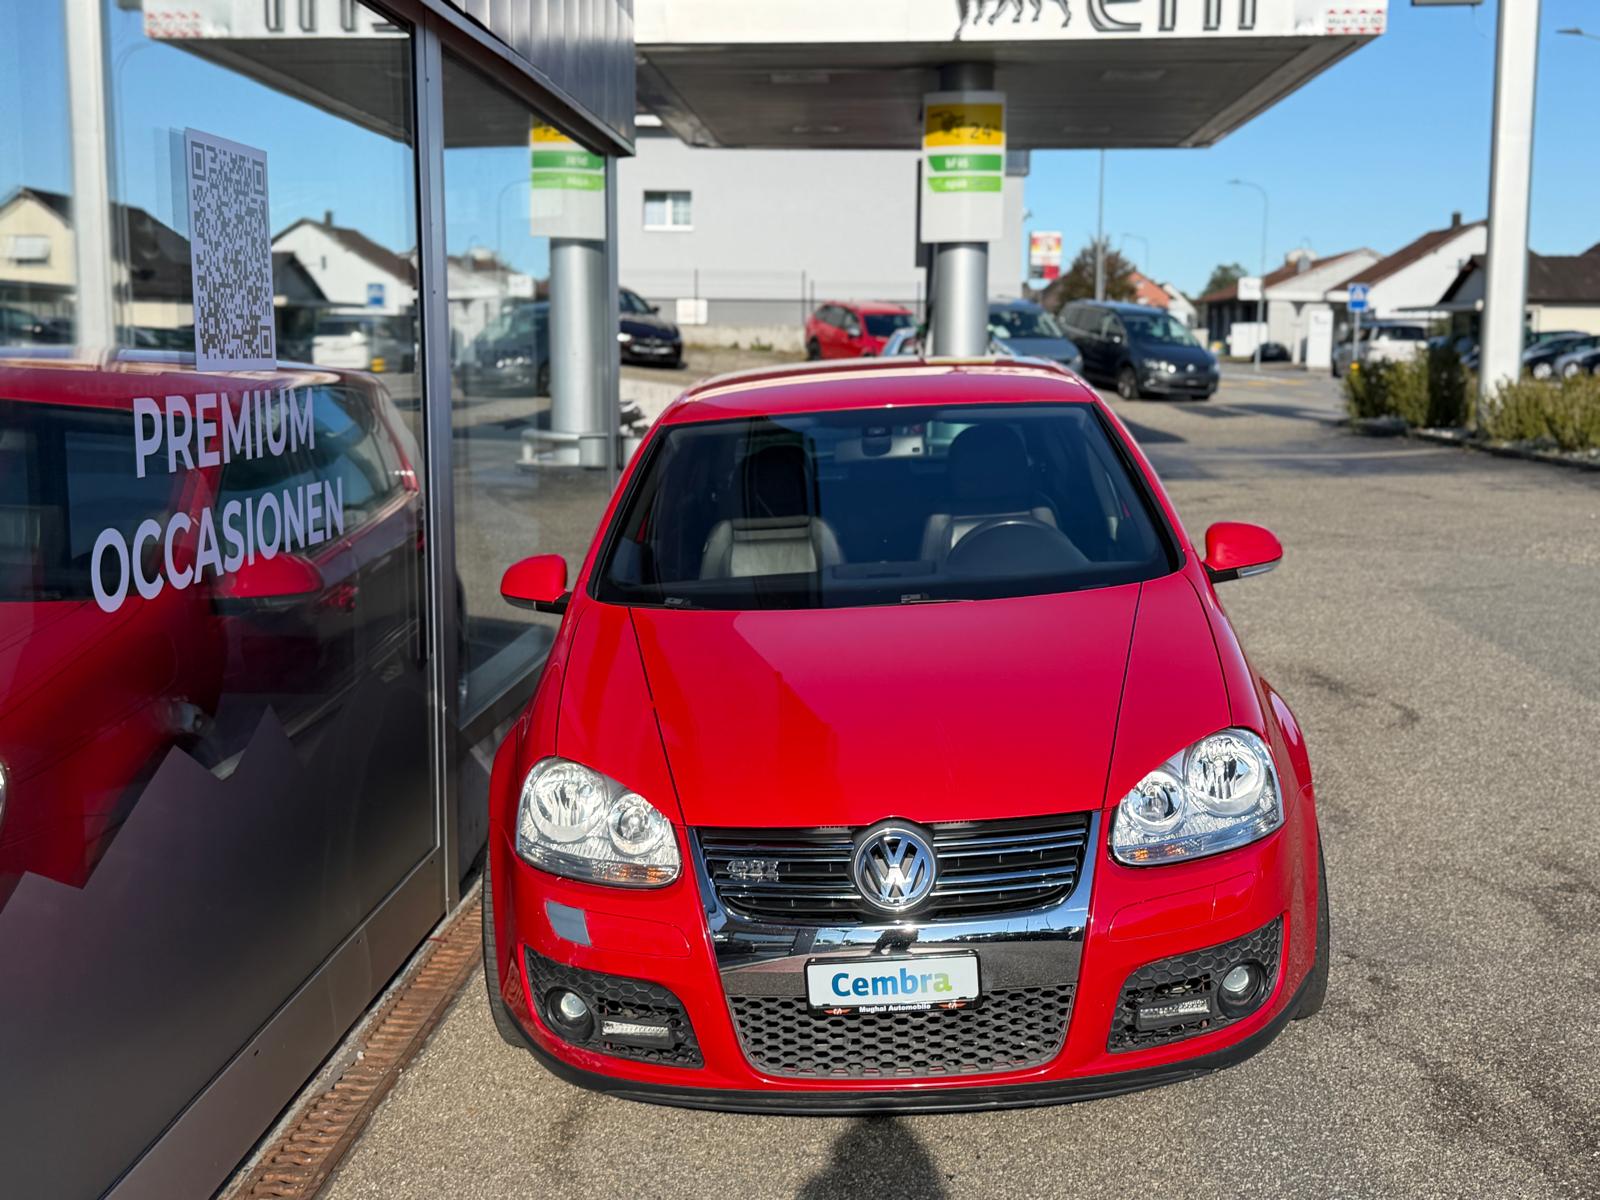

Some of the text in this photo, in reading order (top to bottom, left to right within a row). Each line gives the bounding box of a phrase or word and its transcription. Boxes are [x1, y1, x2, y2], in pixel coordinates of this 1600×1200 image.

[133, 387, 315, 478] PREMIUM
[91, 476, 344, 613] OCCASIONEN
[831, 967, 953, 997] Cembra
[858, 1003, 931, 1014] Mughal Automobile
